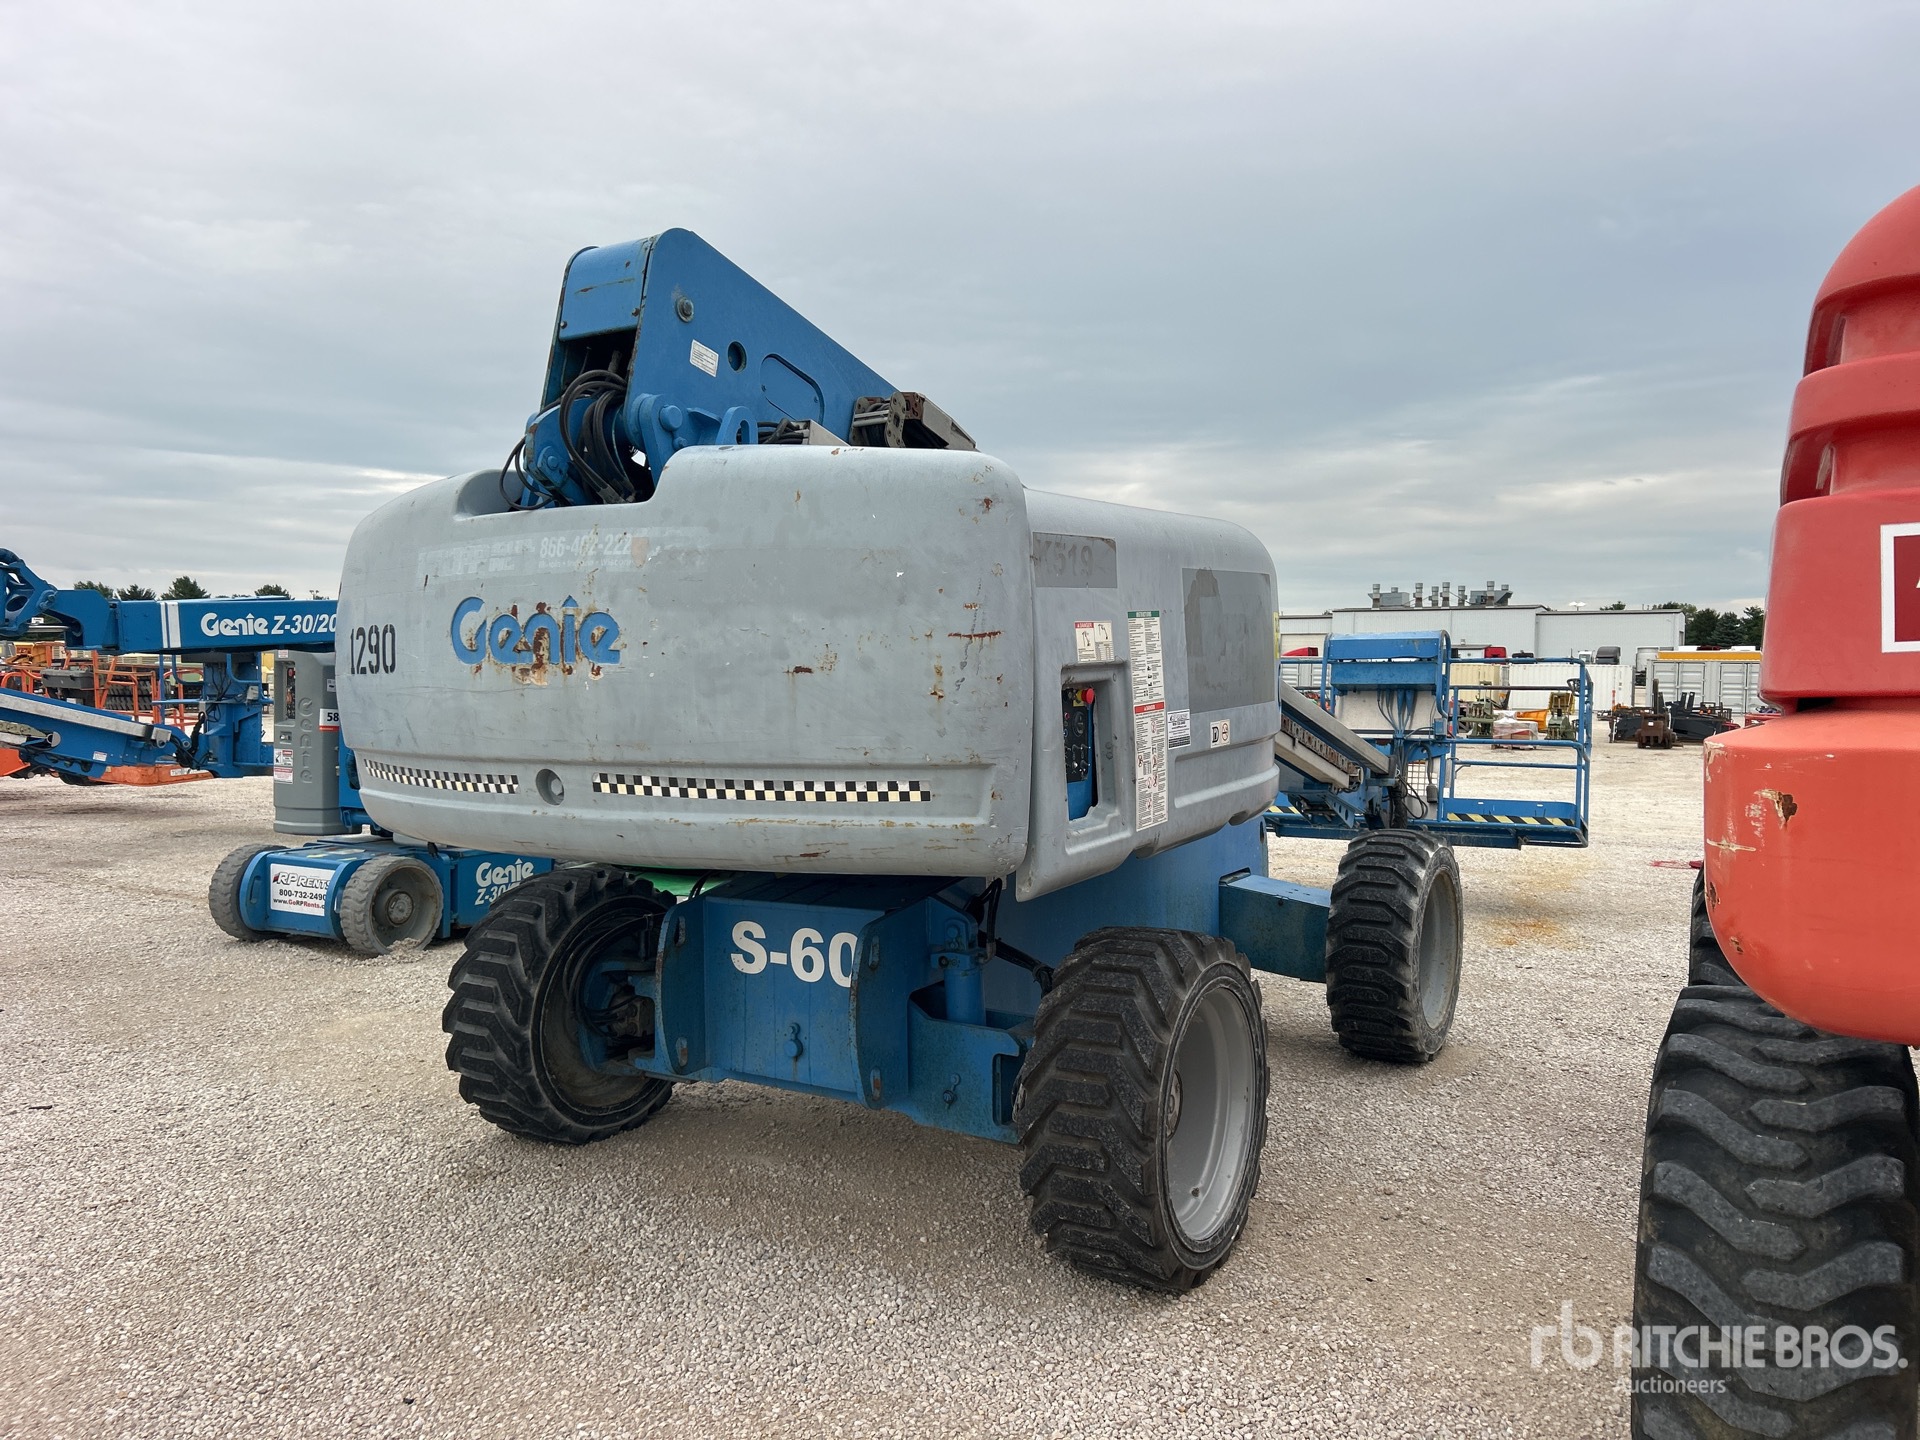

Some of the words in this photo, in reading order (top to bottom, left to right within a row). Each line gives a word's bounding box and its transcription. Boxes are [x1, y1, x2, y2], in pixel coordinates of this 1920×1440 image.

[540, 533, 633, 559] 866-402-222
[201, 612, 269, 637] Genie
[271, 614, 338, 635] Z-30/20
[451, 595, 621, 665] Genie
[351, 624, 396, 675] 1290
[475, 858, 535, 888] Genie
[273, 898, 325, 910] www.GoRPRents.c
[731, 920, 859, 988] S-60
